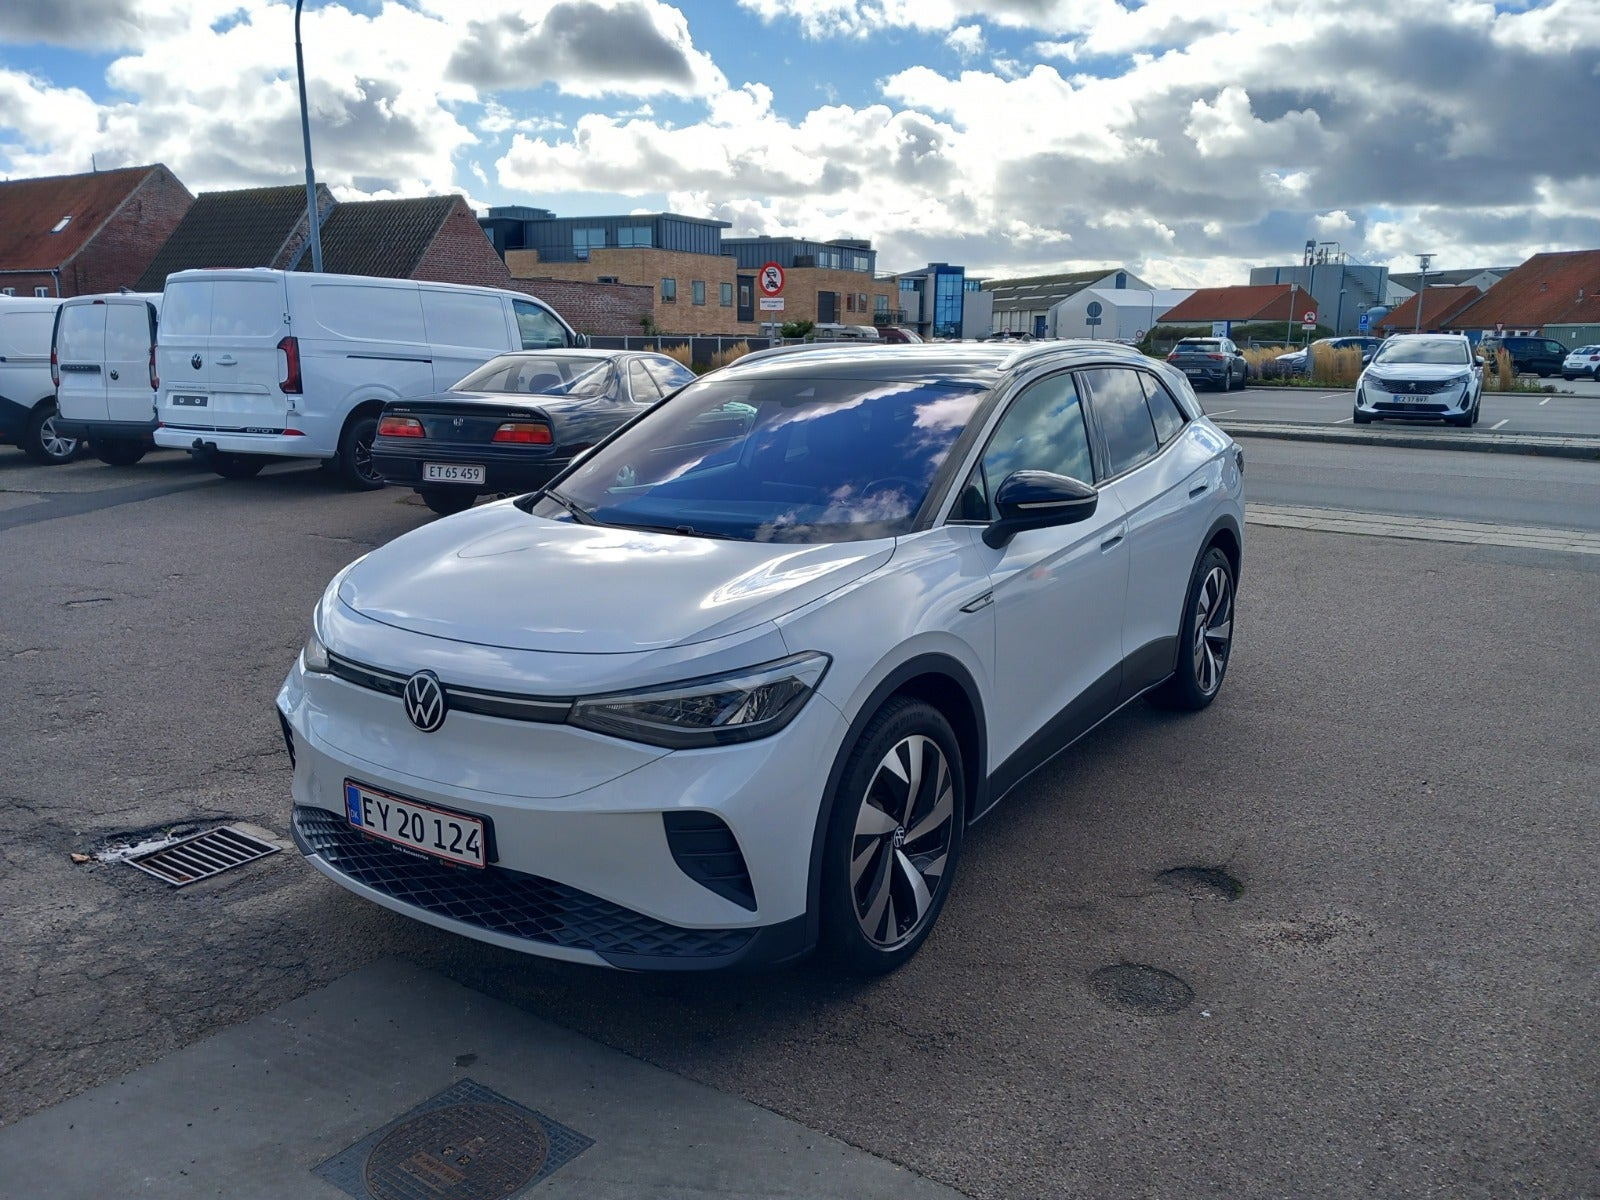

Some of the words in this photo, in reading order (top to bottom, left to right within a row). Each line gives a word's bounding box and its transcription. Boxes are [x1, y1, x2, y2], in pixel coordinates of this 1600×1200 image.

[429, 466, 443, 478] ET
[445, 467, 457, 479] 65
[460, 468, 480, 480] 459
[350, 809, 359, 819] DK
[362, 797, 389, 831] EY
[396, 808, 424, 843] 20
[433, 819, 479, 859] 124
